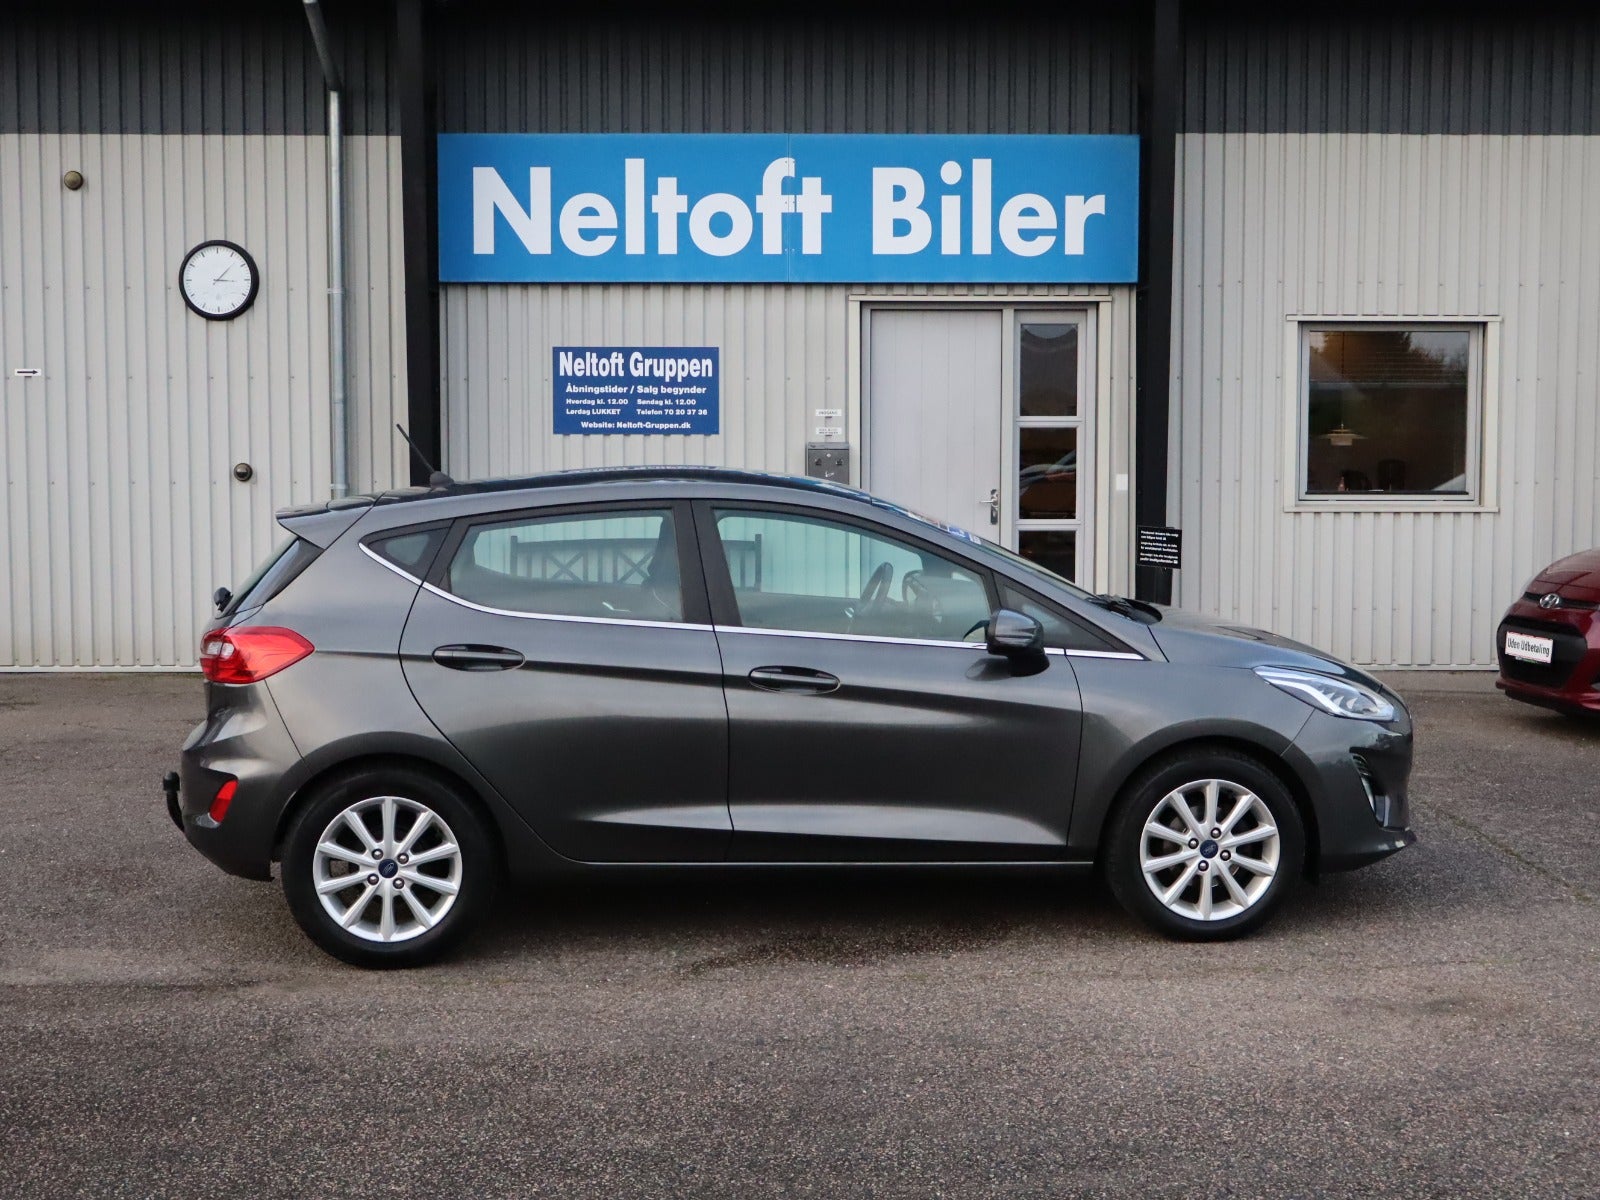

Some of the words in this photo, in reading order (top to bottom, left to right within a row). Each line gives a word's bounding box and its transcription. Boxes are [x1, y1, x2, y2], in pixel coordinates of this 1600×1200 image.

[473, 157, 832, 256] Neltoft
[872, 158, 1106, 256] Biler
[559, 351, 624, 377] Neltoft
[629, 351, 713, 382] Gruppen
[566, 383, 628, 395] Åbningstider
[630, 385, 635, 394] /
[636, 385, 659, 395] Salg
[660, 385, 707, 395] begynder
[566, 398, 596, 406] Hverdag
[636, 398, 663, 406] Søndag
[566, 408, 591, 416] Lørdag
[581, 421, 616, 429] Website:
[616, 421, 692, 430] Neltoft-Gruppen.dk
[1507, 637, 1520, 649] Uden
